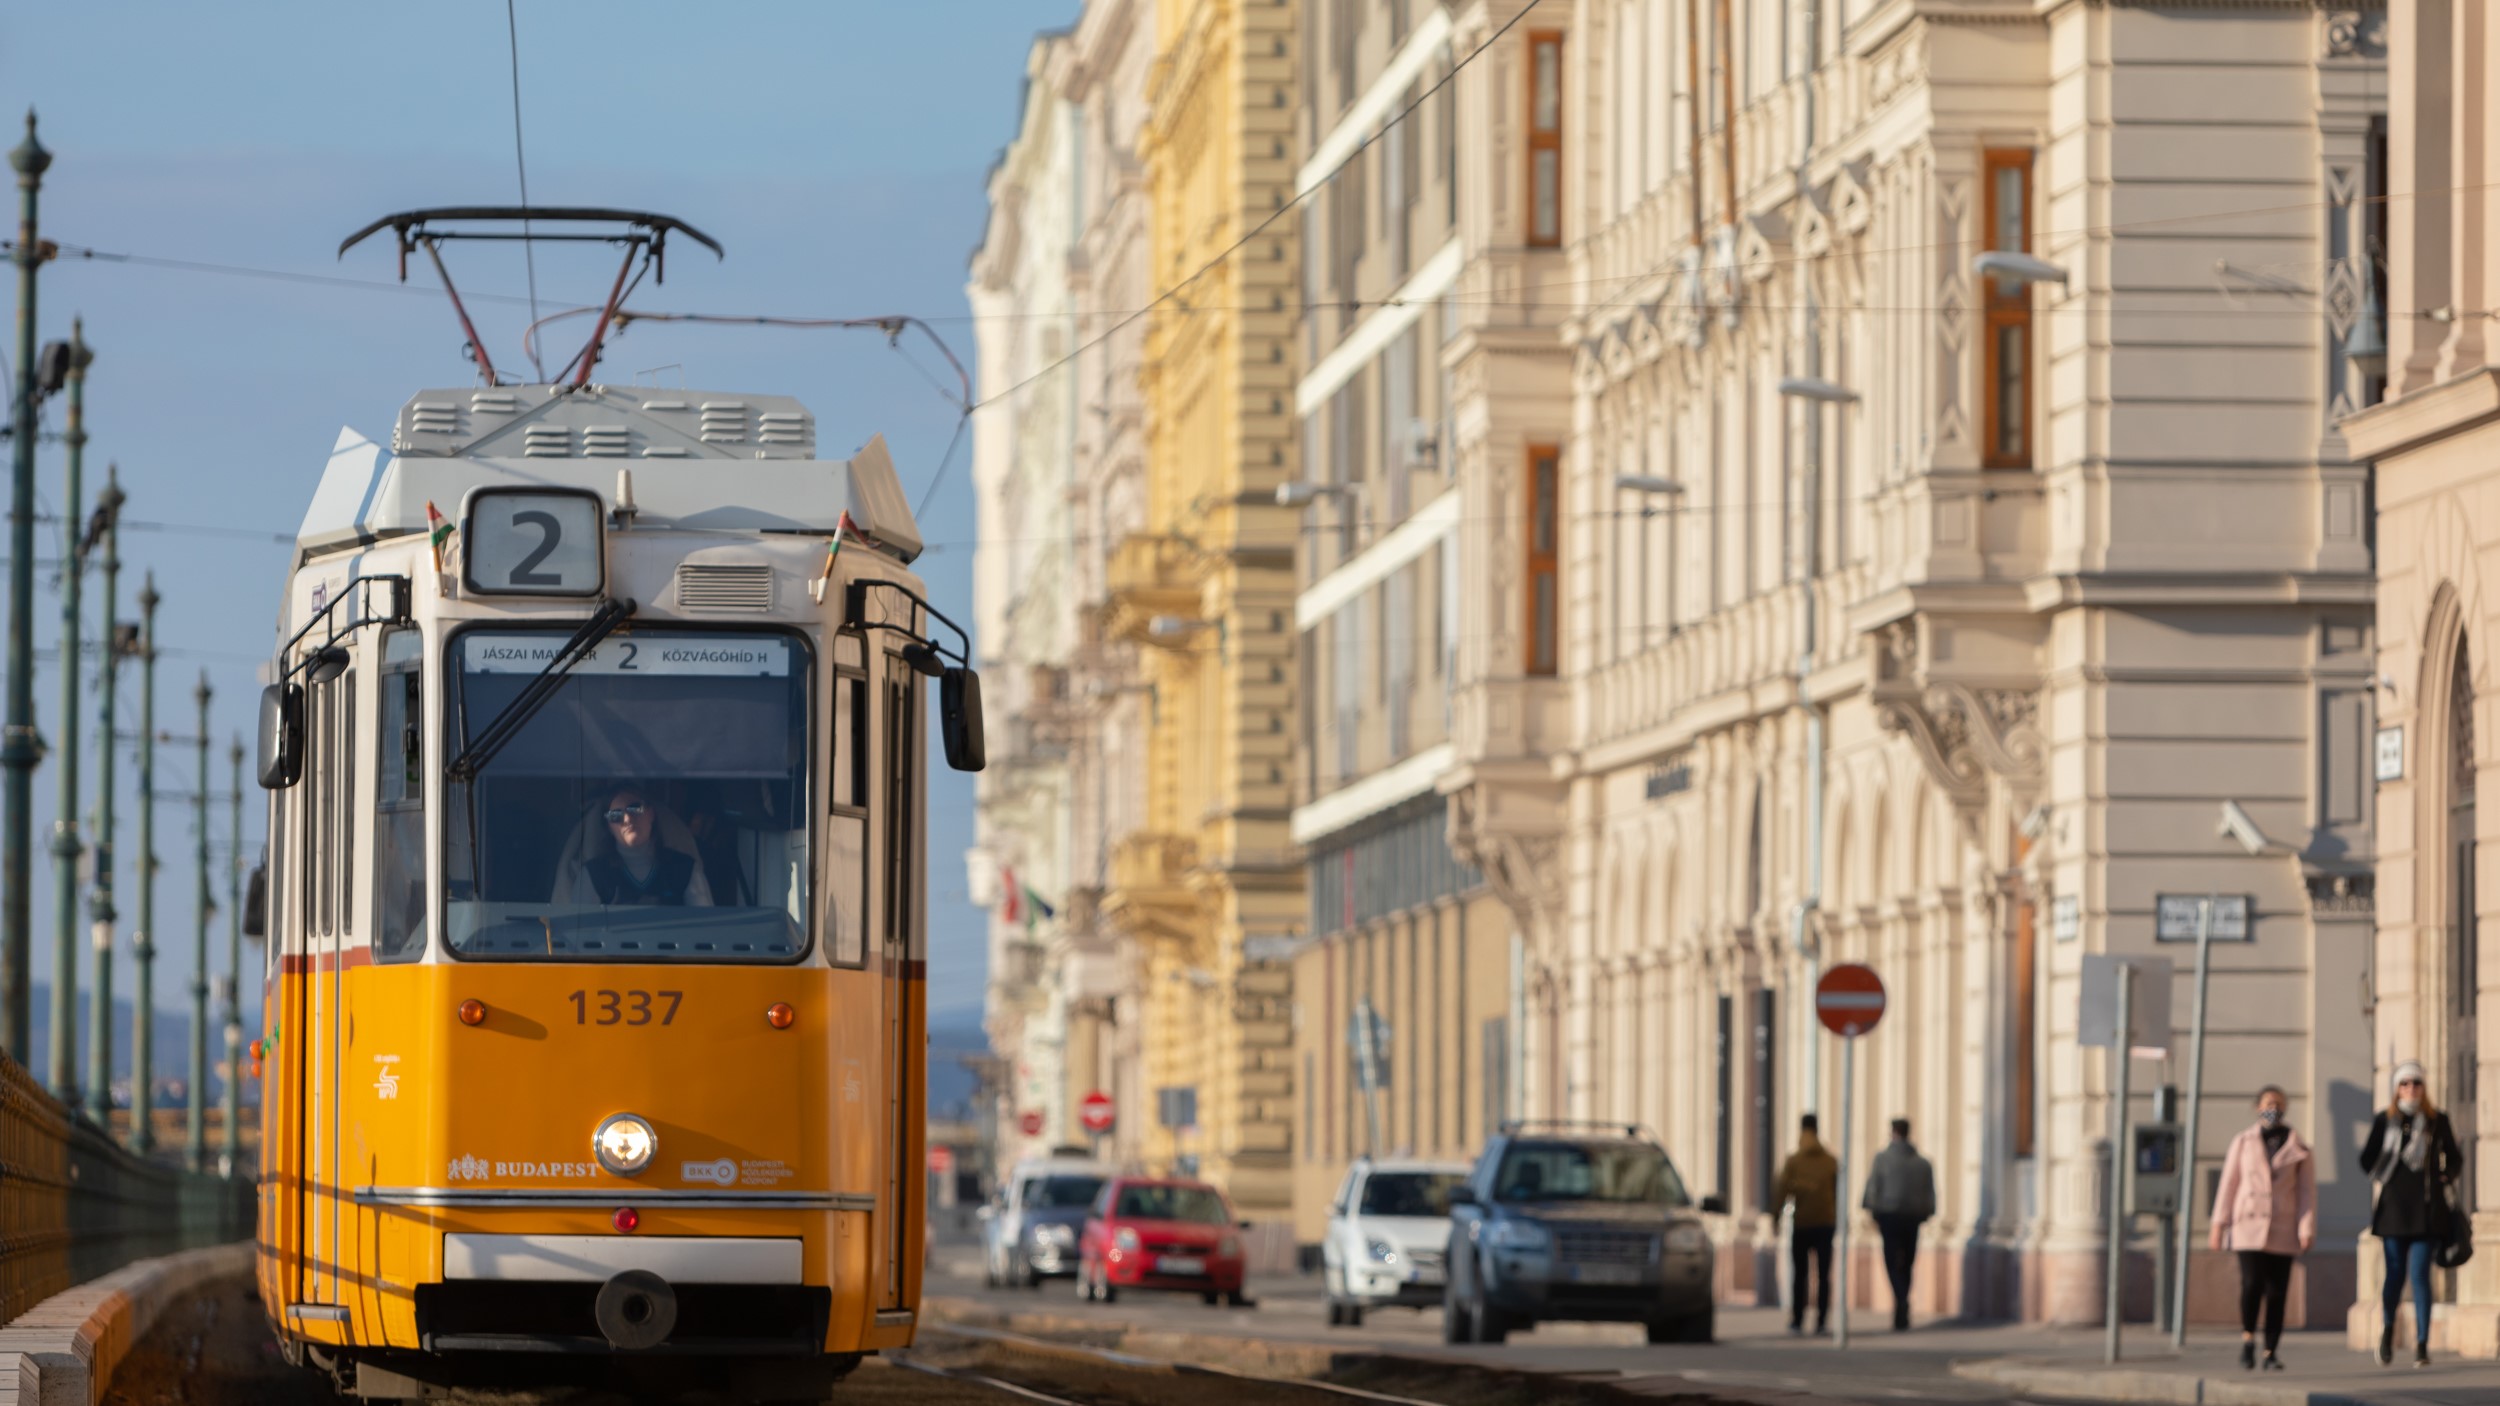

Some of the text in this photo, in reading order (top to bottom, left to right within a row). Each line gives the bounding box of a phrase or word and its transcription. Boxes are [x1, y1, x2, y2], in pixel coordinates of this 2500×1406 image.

[509, 510, 561, 585] 2
[482, 647, 527, 660] JÁSZAI
[618, 642, 638, 669] 2
[662, 648, 753, 663] KÖZVÁGÓHÍD
[758, 652, 767, 663] H
[568, 989, 683, 1026] 1337
[495, 1161, 599, 1177] BUDAPEST
[688, 1166, 712, 1177] BKK
